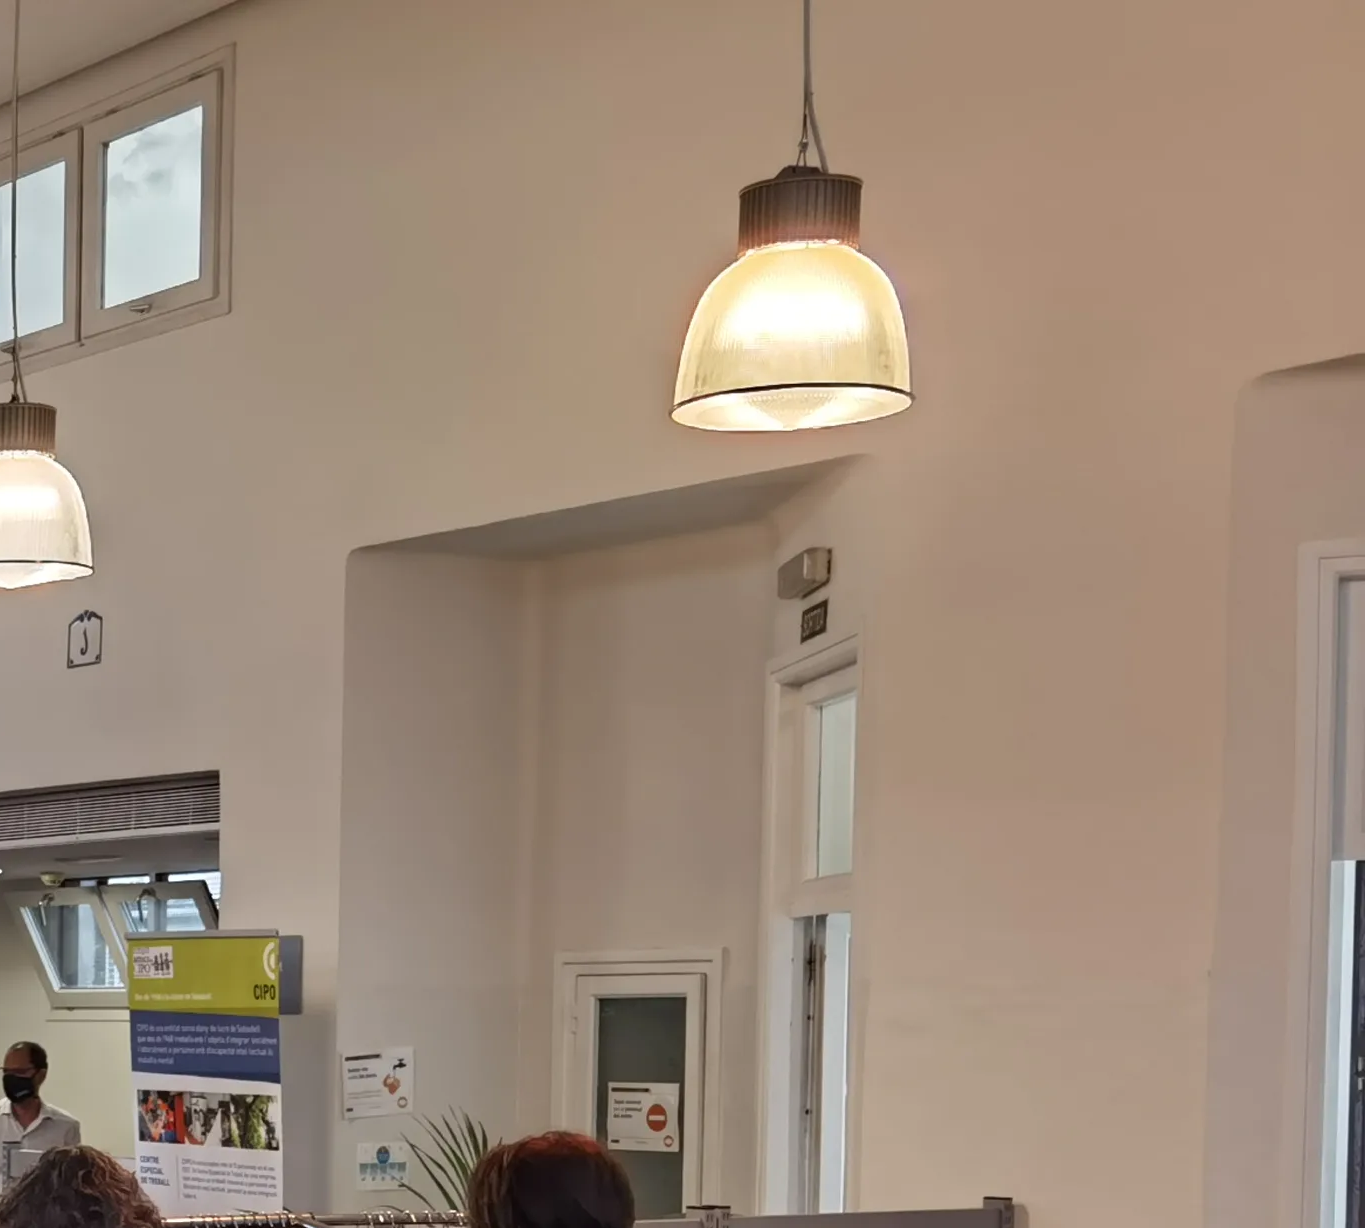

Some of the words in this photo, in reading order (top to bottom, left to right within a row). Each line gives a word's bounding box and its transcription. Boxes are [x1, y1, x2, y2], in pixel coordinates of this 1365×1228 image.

[253, 984, 276, 1000] CIPO
[140, 1155, 159, 1164] CENTRE
[140, 1166, 164, 1175] ESPECIAL
[148, 1177, 171, 1186] TREBALL
